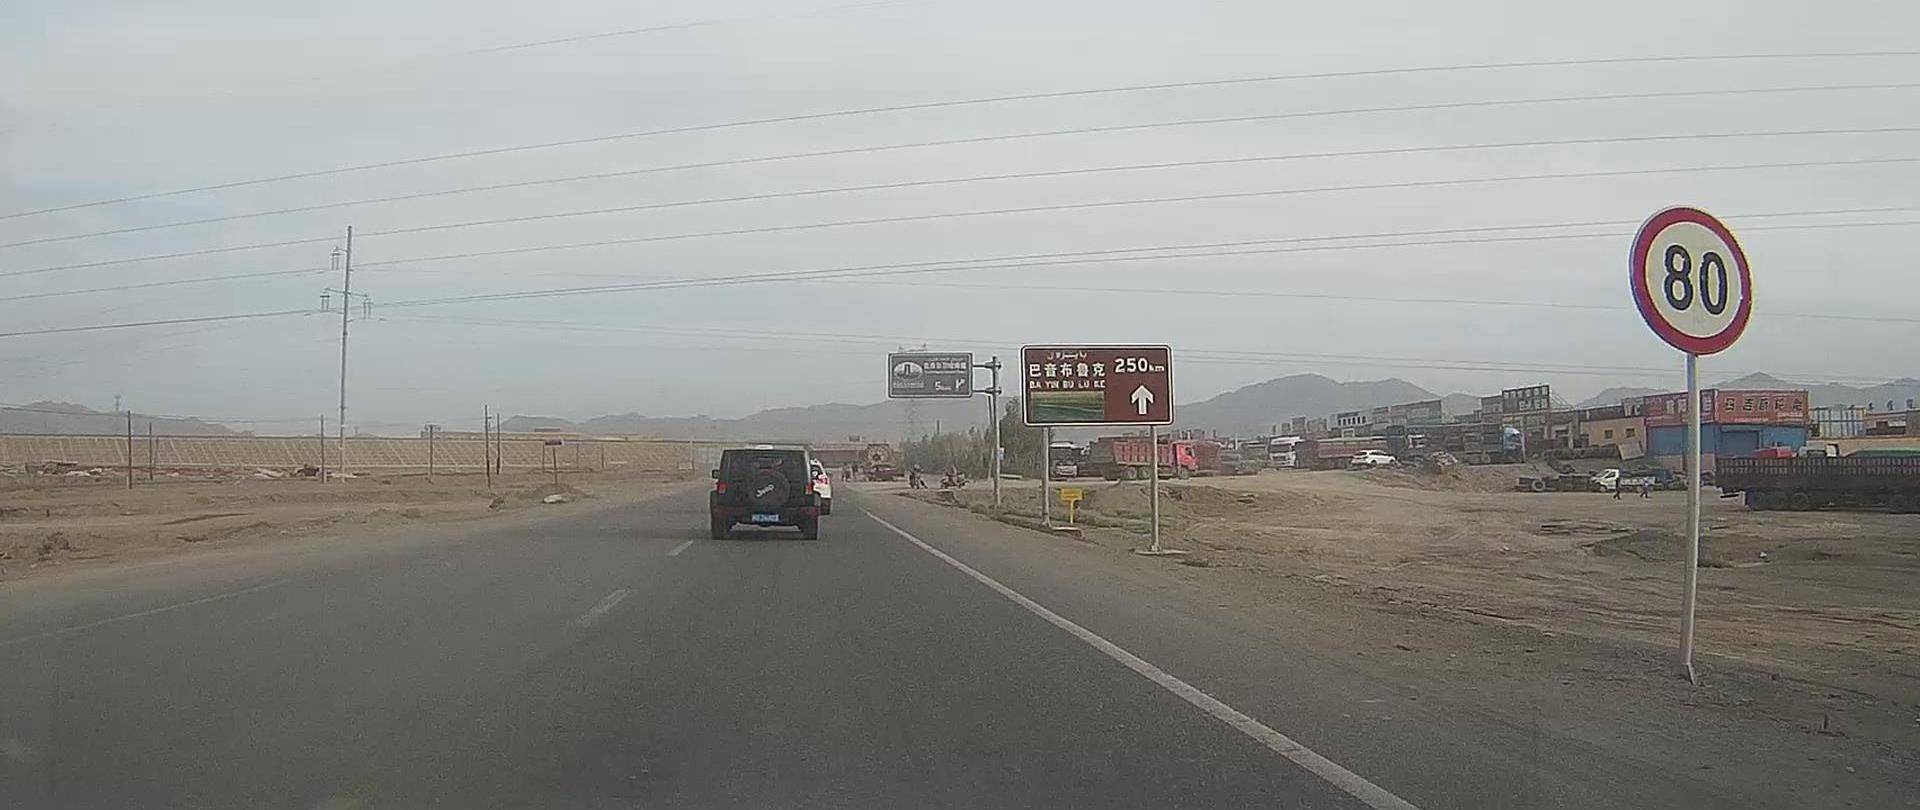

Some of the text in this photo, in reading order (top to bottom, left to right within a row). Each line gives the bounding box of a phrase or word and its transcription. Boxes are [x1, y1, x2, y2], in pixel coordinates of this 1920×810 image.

[1664, 244, 1728, 316] 80
[1029, 362, 1106, 378] 巴音布鲁克
[1029, 380, 1042, 389] BA
